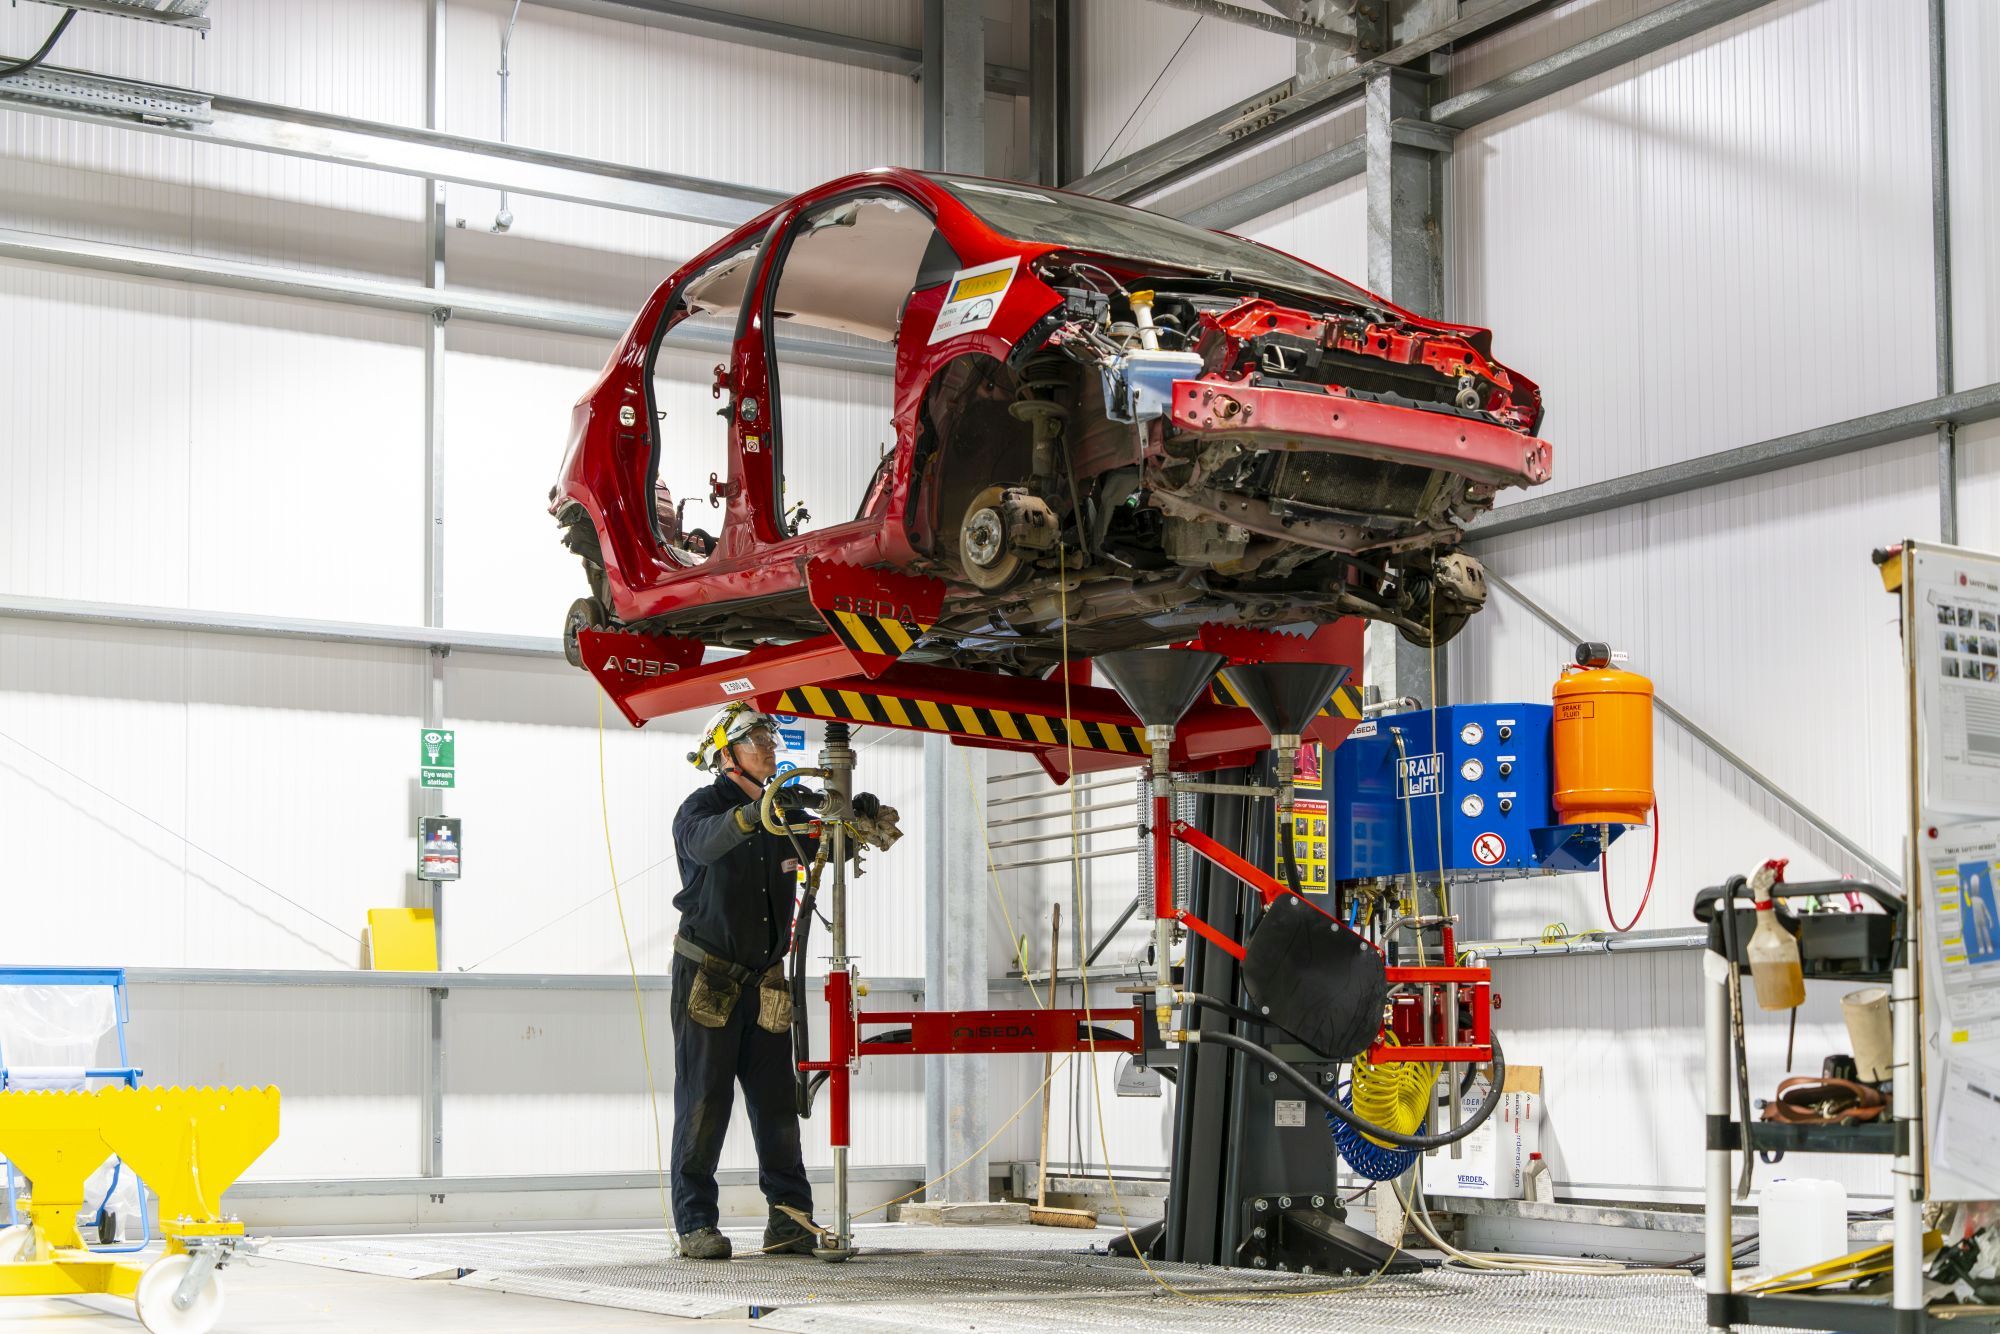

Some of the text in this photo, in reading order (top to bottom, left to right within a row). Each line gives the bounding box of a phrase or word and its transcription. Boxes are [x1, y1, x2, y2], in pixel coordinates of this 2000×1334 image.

[833, 595, 916, 623] SEDA
[1356, 725, 1377, 734] SEDA
[423, 770, 435, 778] Eye
[1400, 756, 1441, 778] DRAIN
[1409, 775, 1436, 794] LIFT
[979, 1025, 1034, 1038] SEDA
[1514, 1135, 1522, 1188] rderair.com
[1457, 1174, 1483, 1183] VERDER
